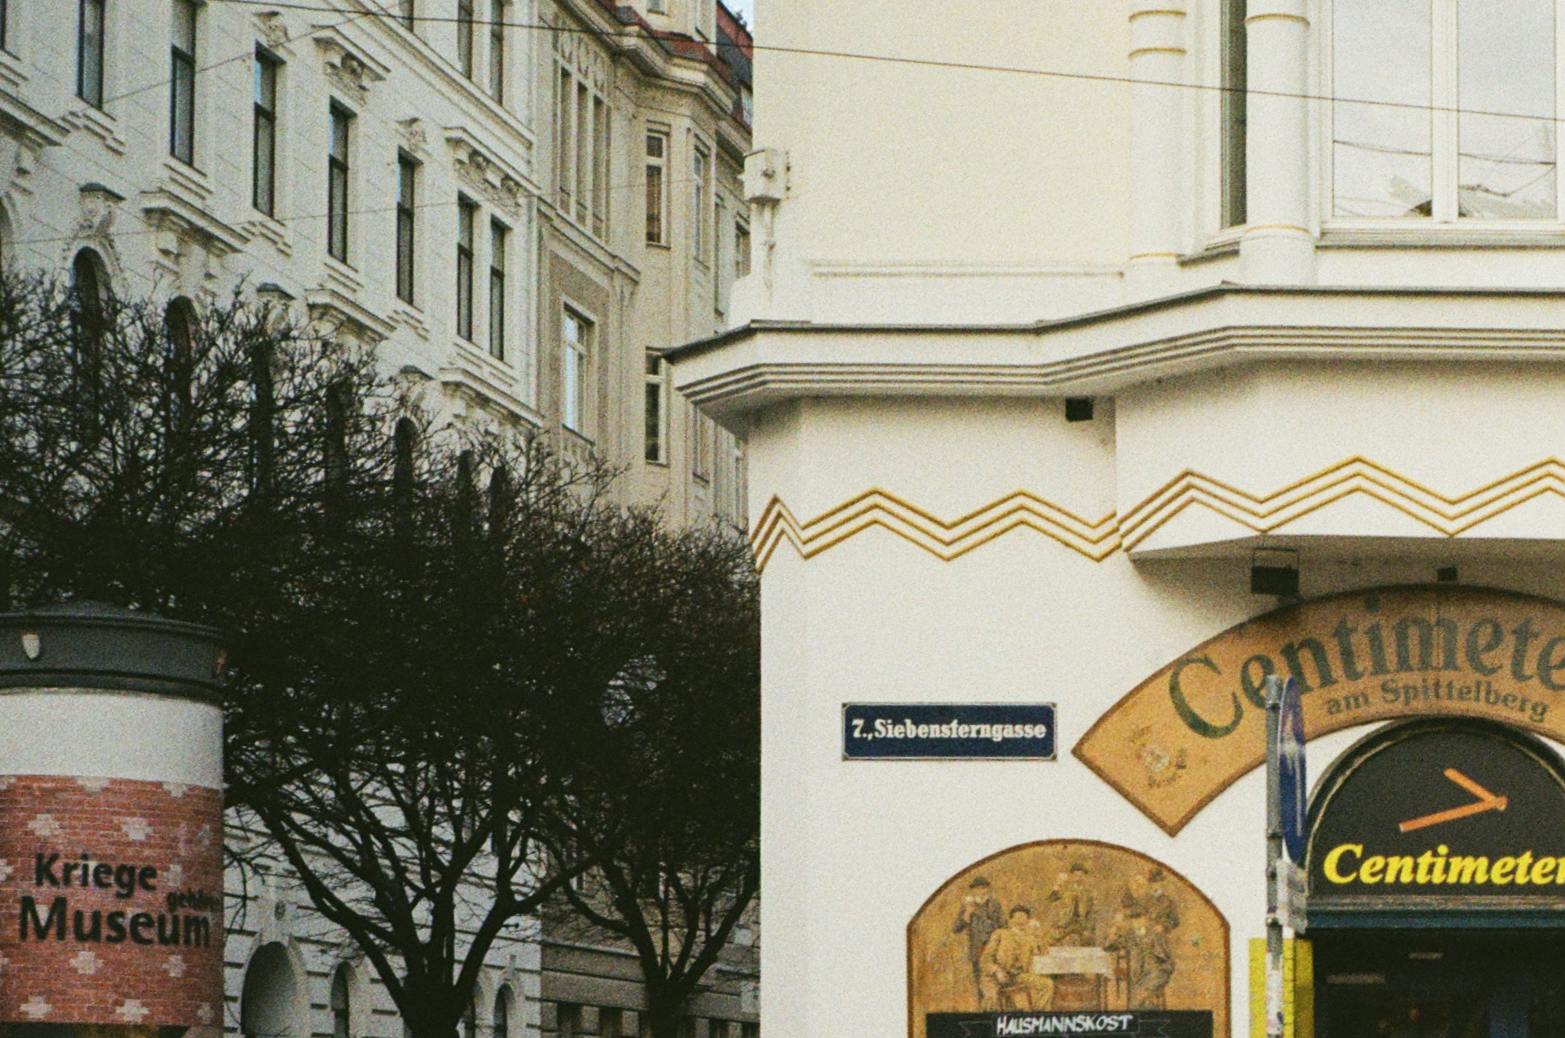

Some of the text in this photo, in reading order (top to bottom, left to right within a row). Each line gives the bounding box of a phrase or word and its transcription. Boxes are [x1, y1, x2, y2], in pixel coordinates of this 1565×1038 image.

[1326, 678, 1552, 723] am Spittelberg
[35, 853, 158, 898] Kriege
[19, 895, 210, 946] Museum
[997, 1015, 1133, 1035] HAUSMANNSKOST
